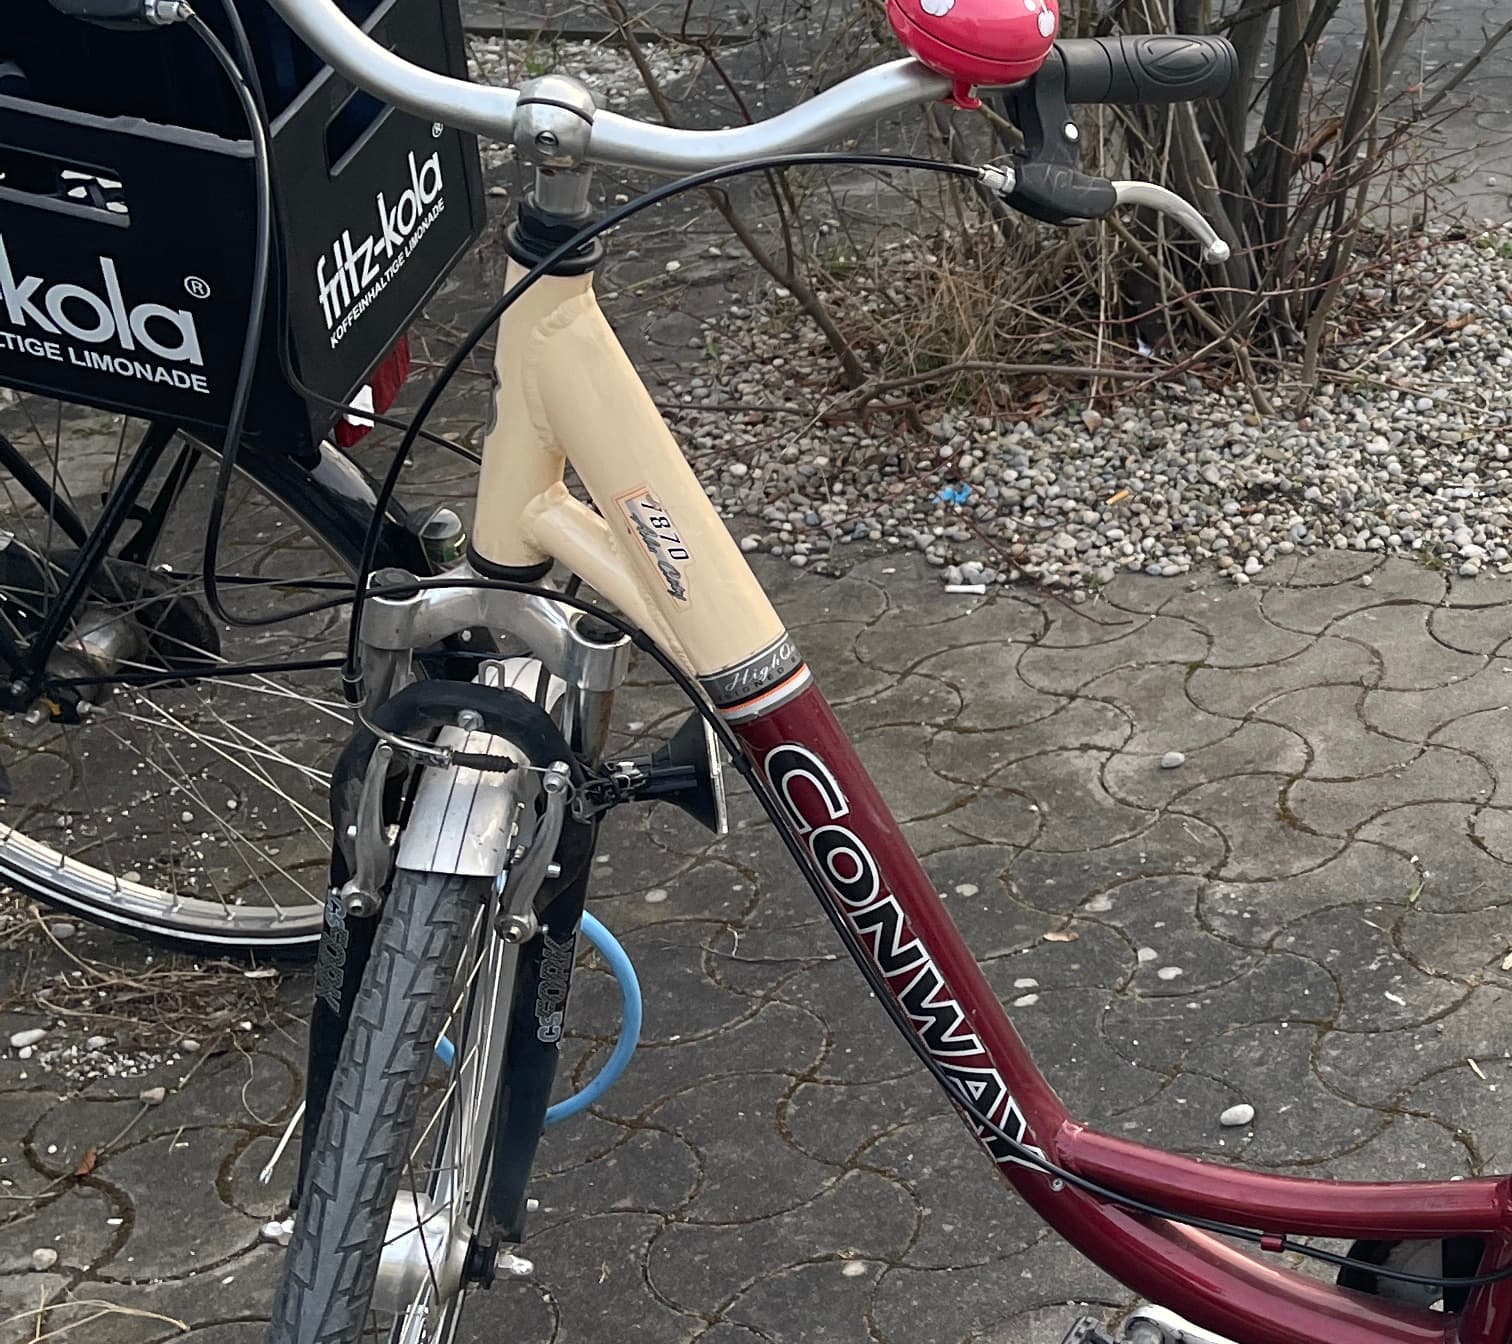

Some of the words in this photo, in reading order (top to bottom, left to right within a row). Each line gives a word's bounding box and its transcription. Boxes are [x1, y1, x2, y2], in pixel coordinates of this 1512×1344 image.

[0, 233, 204, 367] kola
[316, 150, 443, 329] fritz-kola
[330, 254, 405, 349] KOFFEINHALTIGE
[404, 197, 445, 259] LIMONADE
[67, 347, 210, 394] LIMONADE
[764, 743, 1052, 1173] CONWAY
